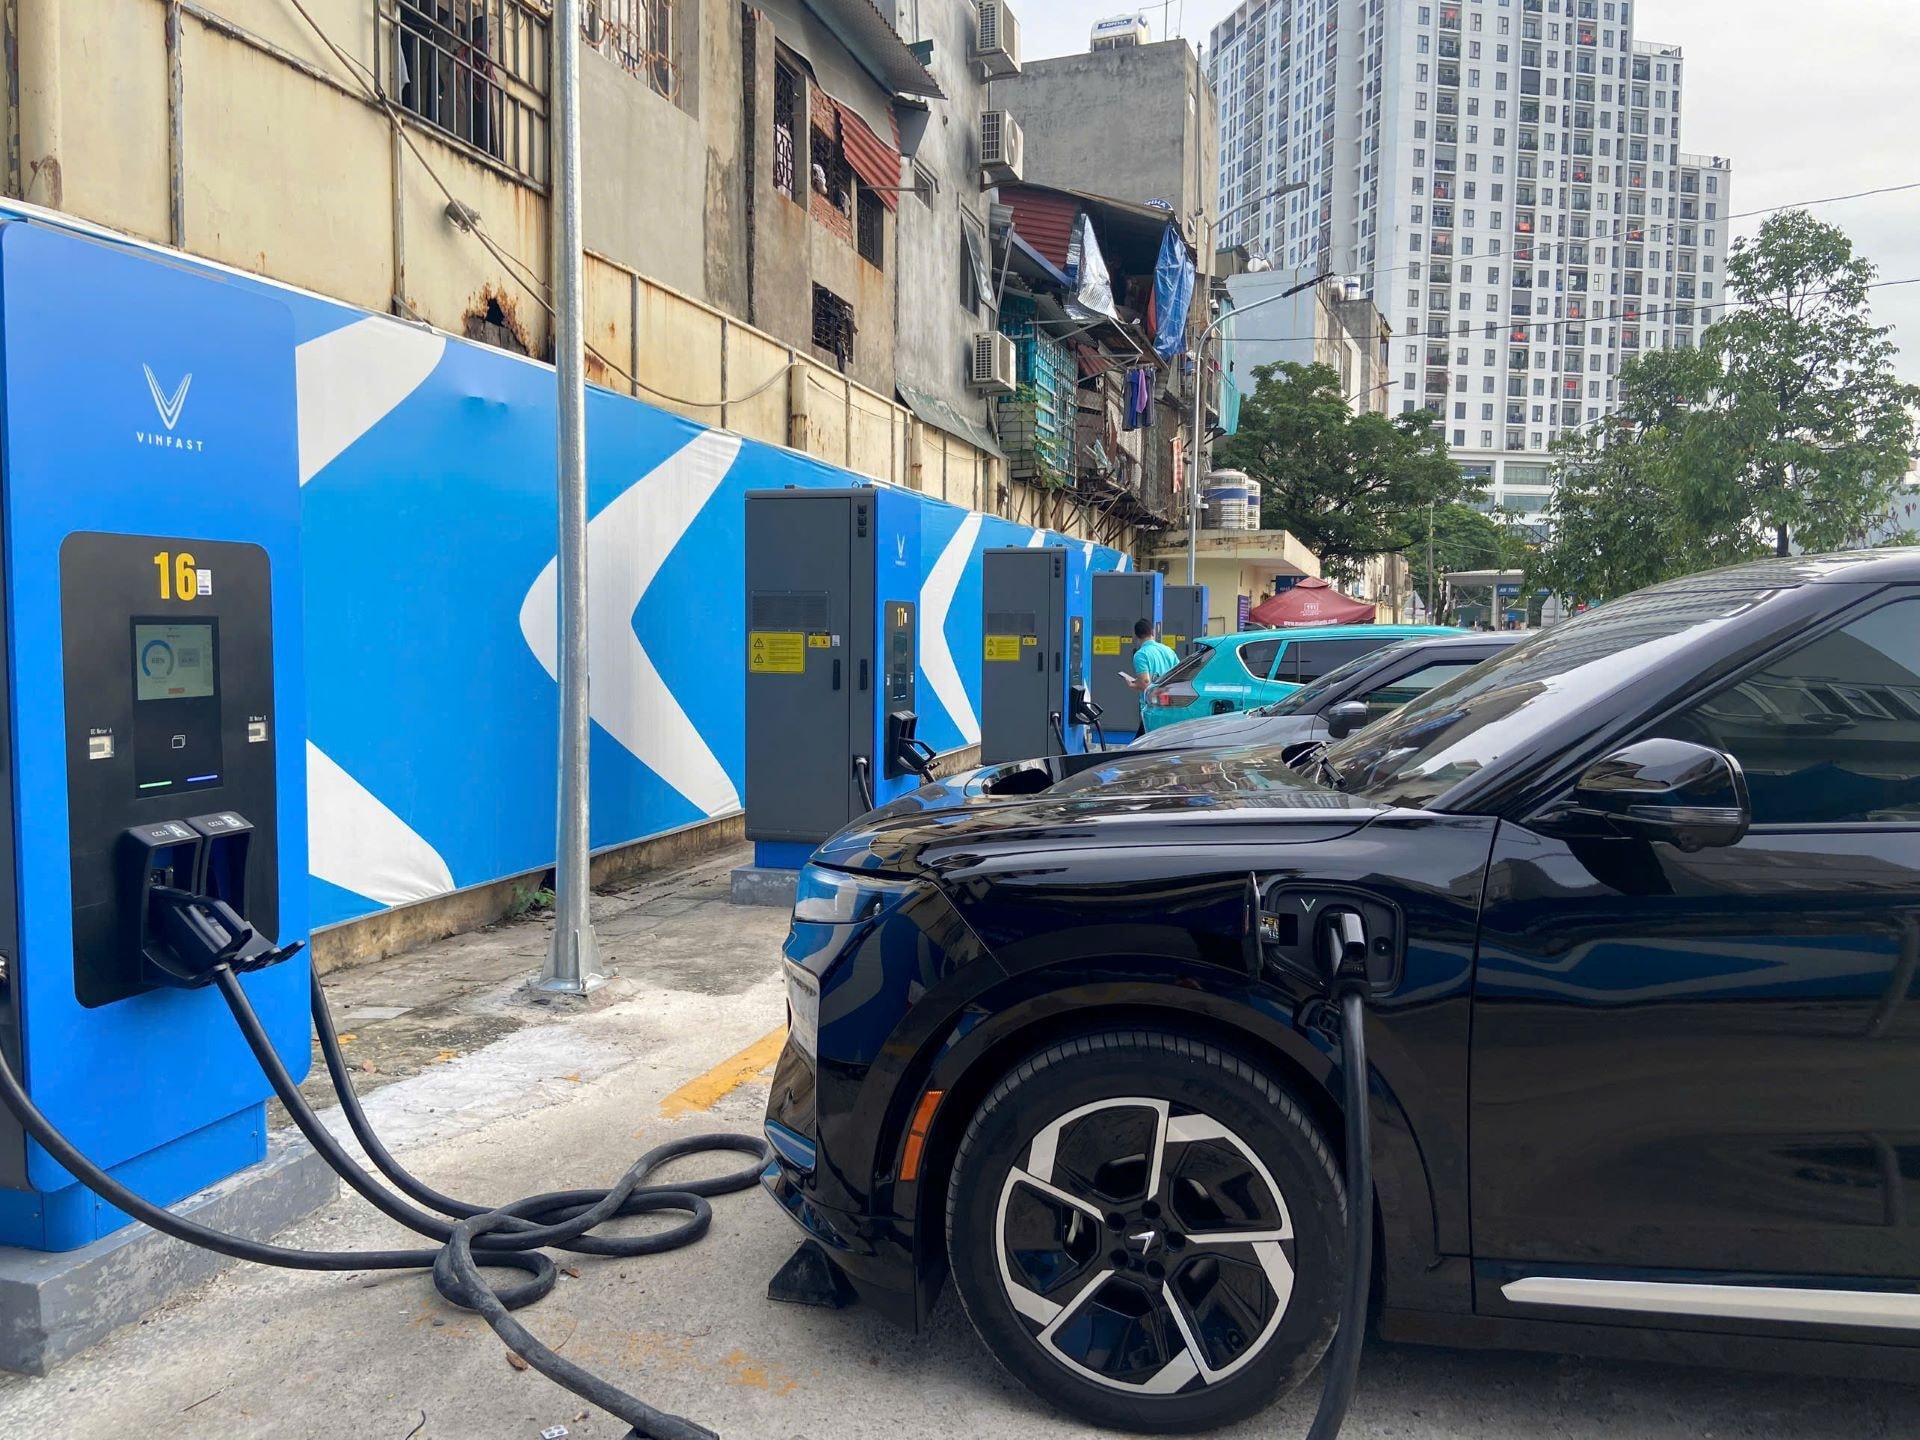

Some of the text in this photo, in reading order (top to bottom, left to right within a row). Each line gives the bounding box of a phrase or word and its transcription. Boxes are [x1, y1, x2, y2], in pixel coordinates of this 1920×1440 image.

[136, 431, 203, 451] VINFAST
[153, 551, 197, 601] 16
[896, 607, 905, 627] 17
